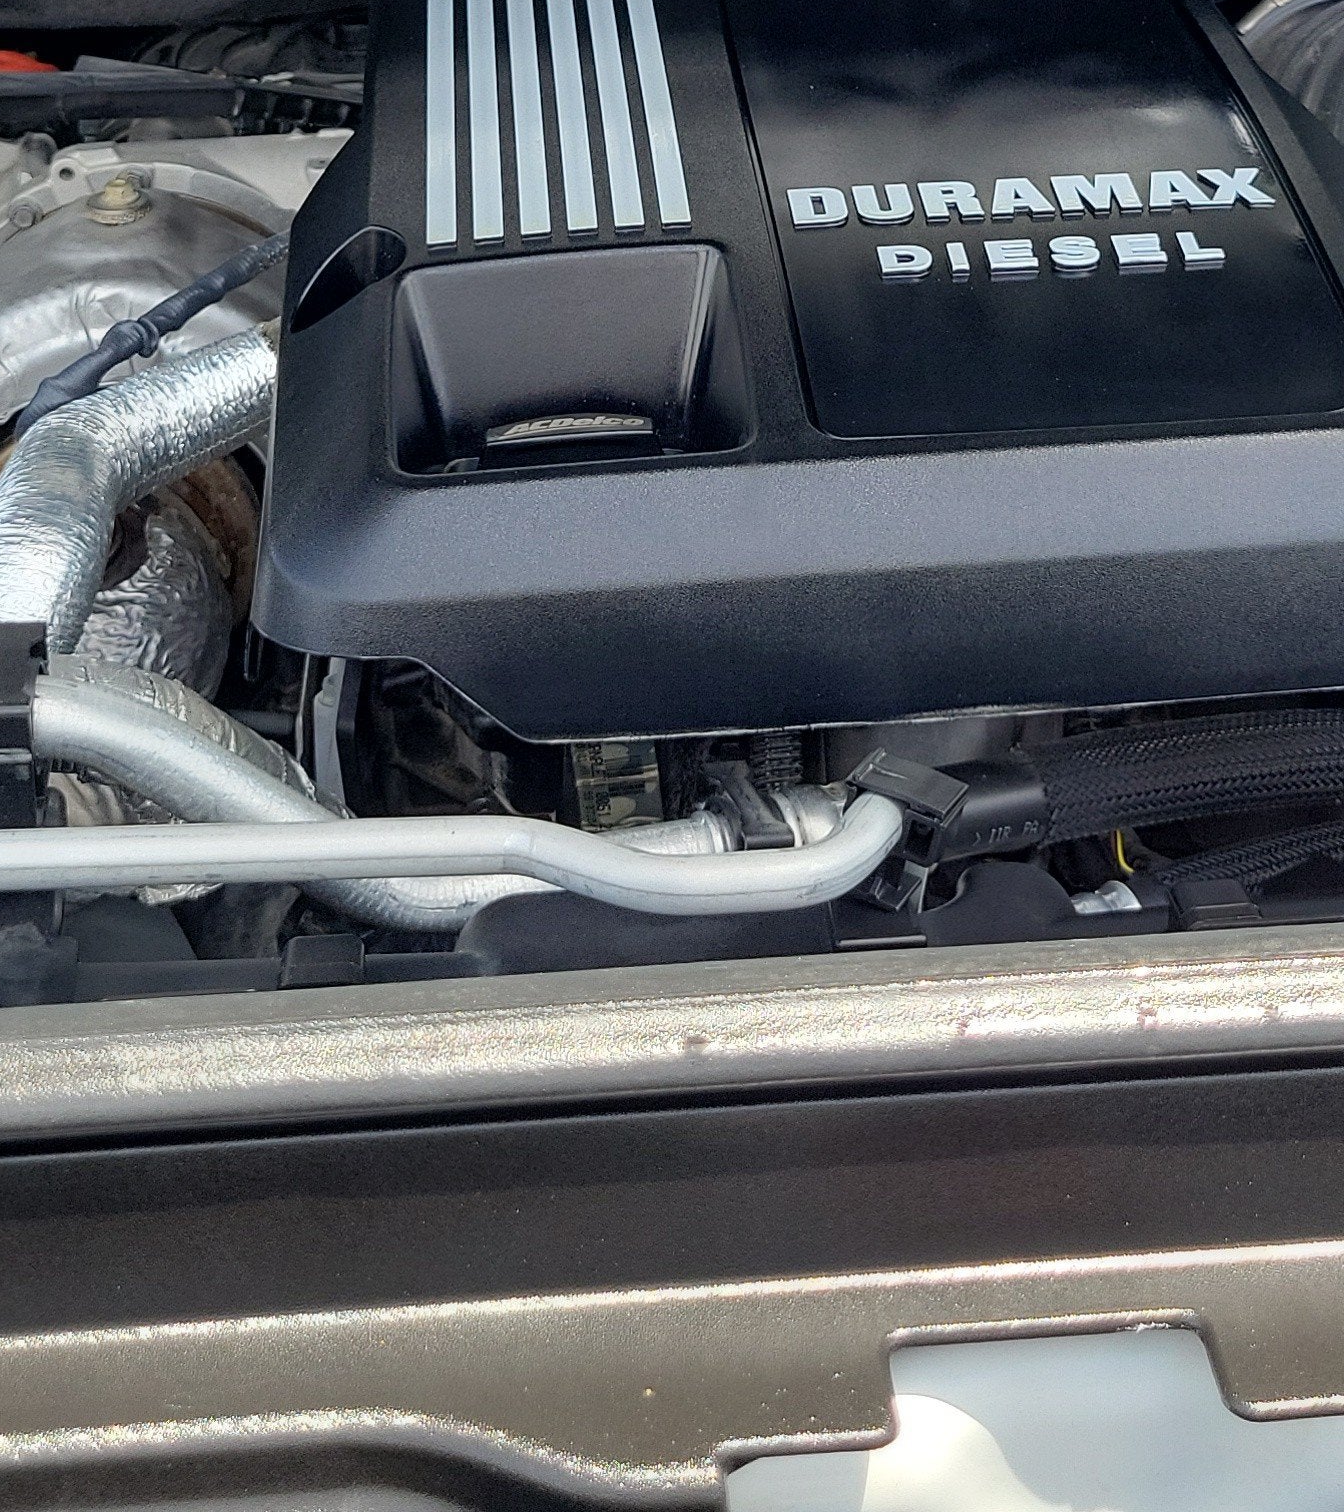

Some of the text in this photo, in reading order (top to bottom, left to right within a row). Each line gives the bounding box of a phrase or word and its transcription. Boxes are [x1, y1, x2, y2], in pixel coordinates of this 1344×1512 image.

[786, 167, 1276, 227] DURAMAX
[876, 232, 1227, 279] DIESEL
[503, 416, 645, 435] ACDelco
